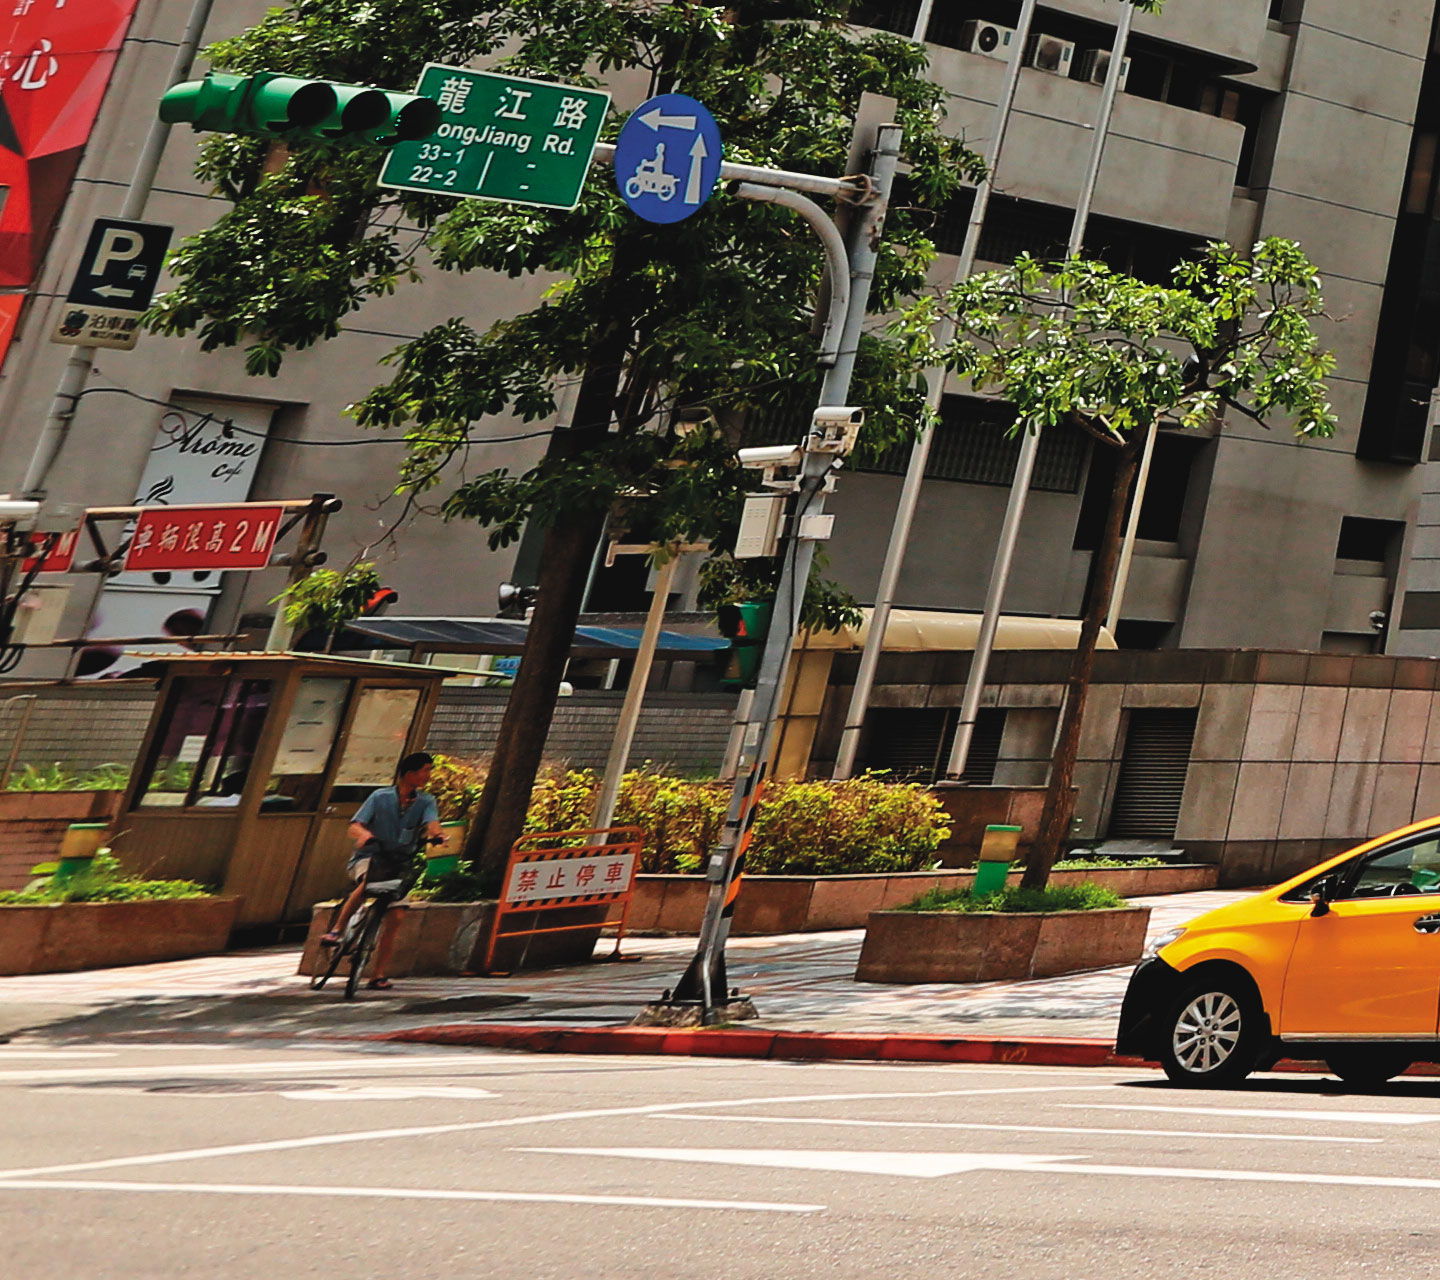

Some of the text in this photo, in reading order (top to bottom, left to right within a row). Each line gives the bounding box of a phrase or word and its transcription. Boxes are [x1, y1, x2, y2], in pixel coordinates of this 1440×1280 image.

[437, 76, 589, 130] 龍江路
[418, 143, 466, 164] 33-1
[437, 123, 576, 156] ongJiang Rd.
[408, 165, 458, 186] 22-2
[89, 227, 144, 276] P
[516, 861, 625, 893] 禁止停車
